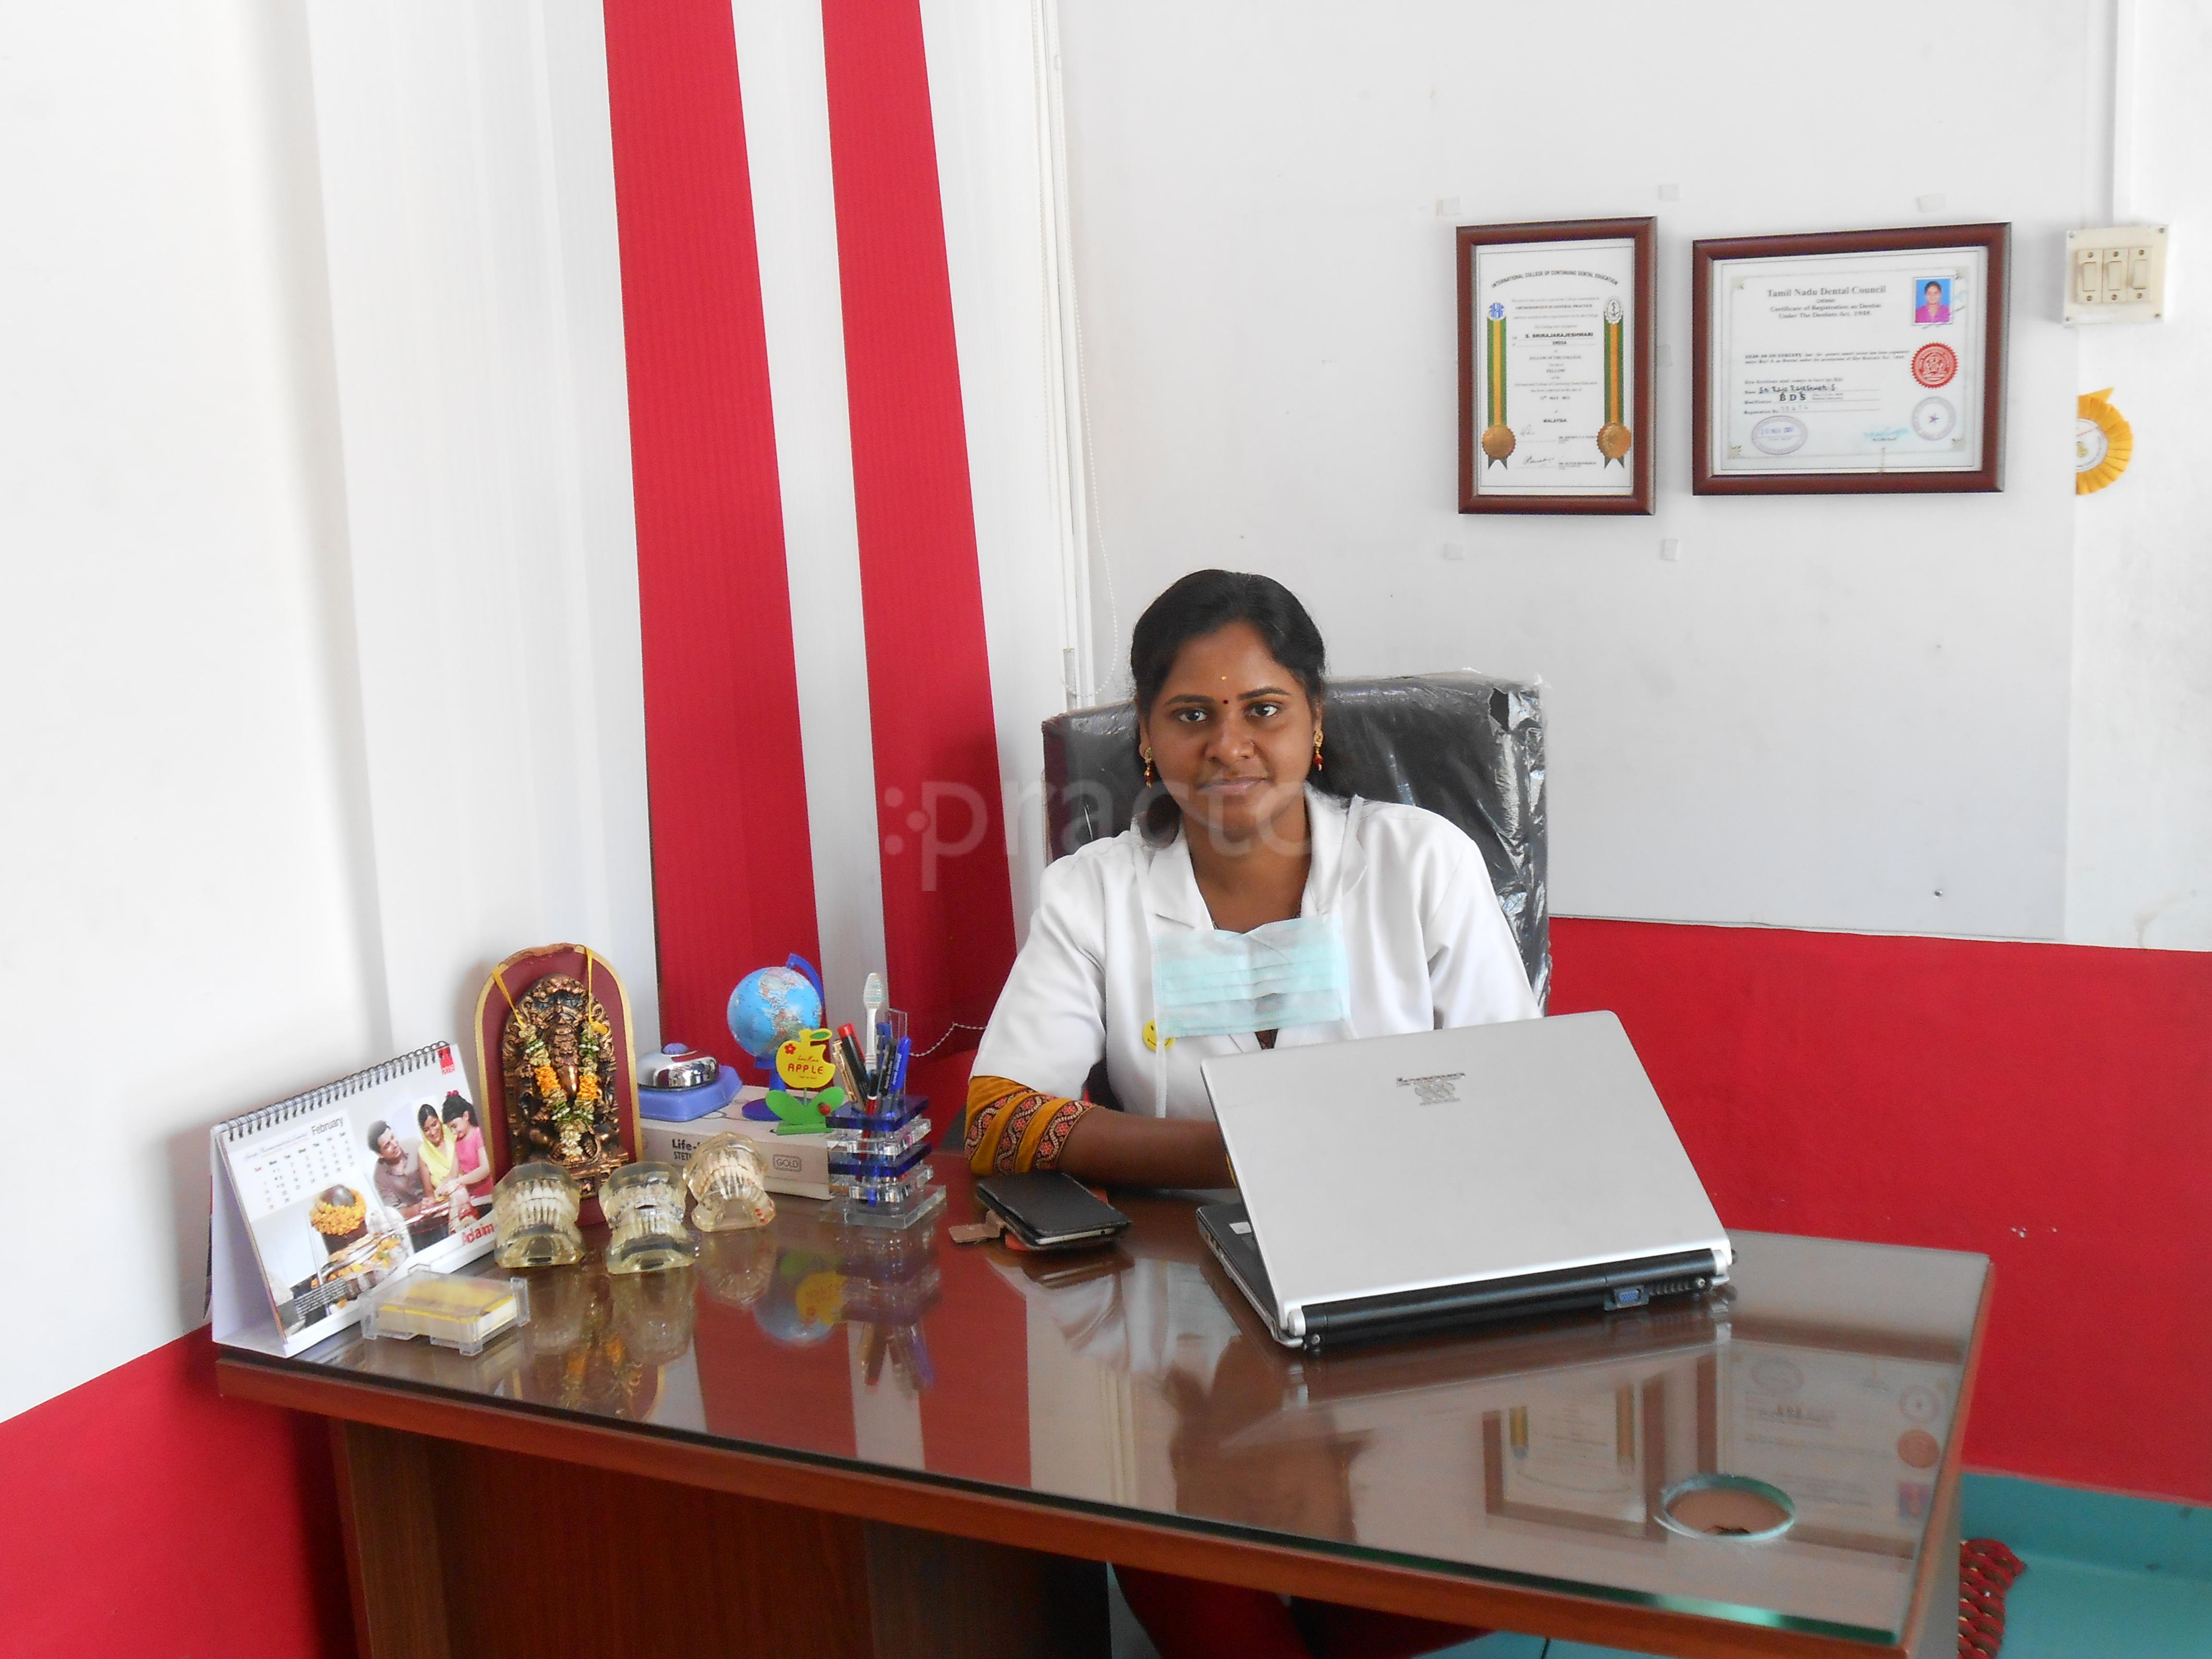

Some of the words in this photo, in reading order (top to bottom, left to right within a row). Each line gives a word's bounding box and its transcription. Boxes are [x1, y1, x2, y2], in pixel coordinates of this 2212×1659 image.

[1595, 273, 1618, 285] EDUCATION
[1767, 289, 1792, 297] Tamil
[1794, 288, 1818, 296] Nadu
[1820, 287, 1850, 296] Dental
[1851, 285, 1887, 294] Council
[787, 1063, 824, 1074] APPLE
[311, 1117, 344, 1136] February
[776, 1158, 799, 1168] GOLD
